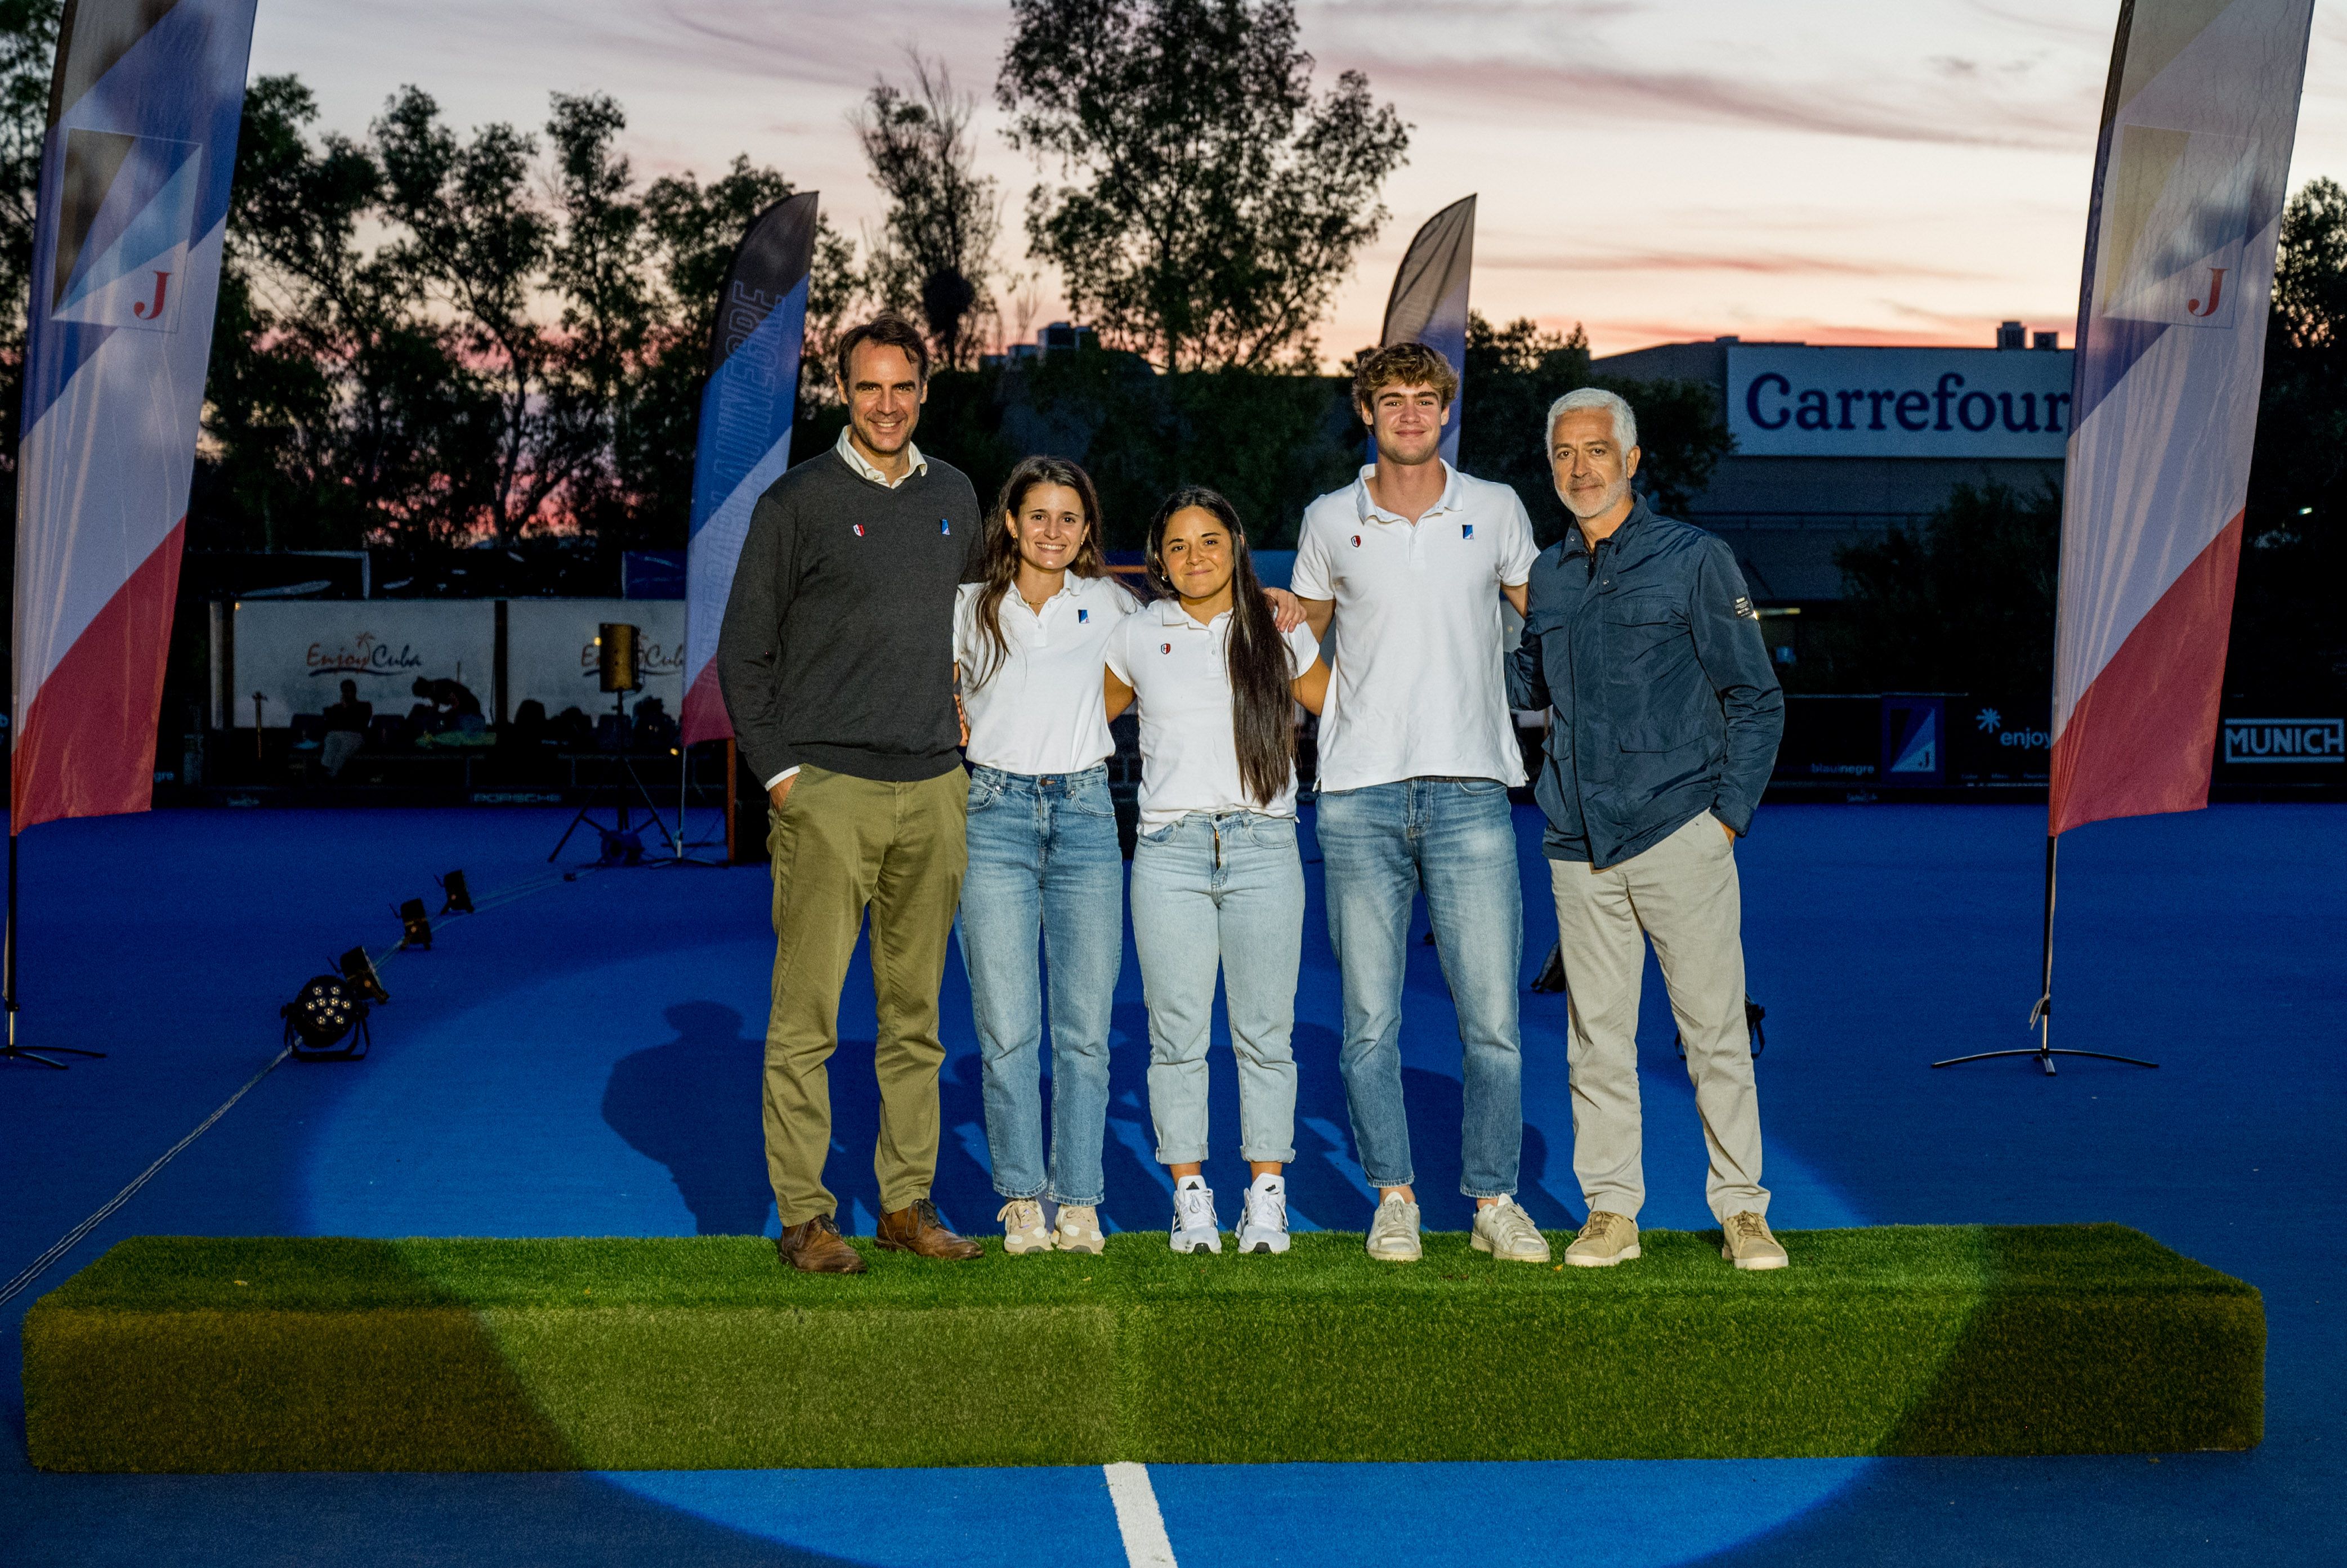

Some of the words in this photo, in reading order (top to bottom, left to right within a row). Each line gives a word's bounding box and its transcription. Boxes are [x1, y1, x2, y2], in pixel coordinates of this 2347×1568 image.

[133, 271, 172, 320] J
[2188, 267, 2230, 317] J
[1746, 372, 2069, 432] Carrefour
[307, 642, 369, 673] Enjoy
[372, 643, 422, 668] Cuba
[646, 644, 684, 668] Cub
[1999, 726, 2051, 750] enjoy
[2224, 725, 2346, 755] MUNICH
